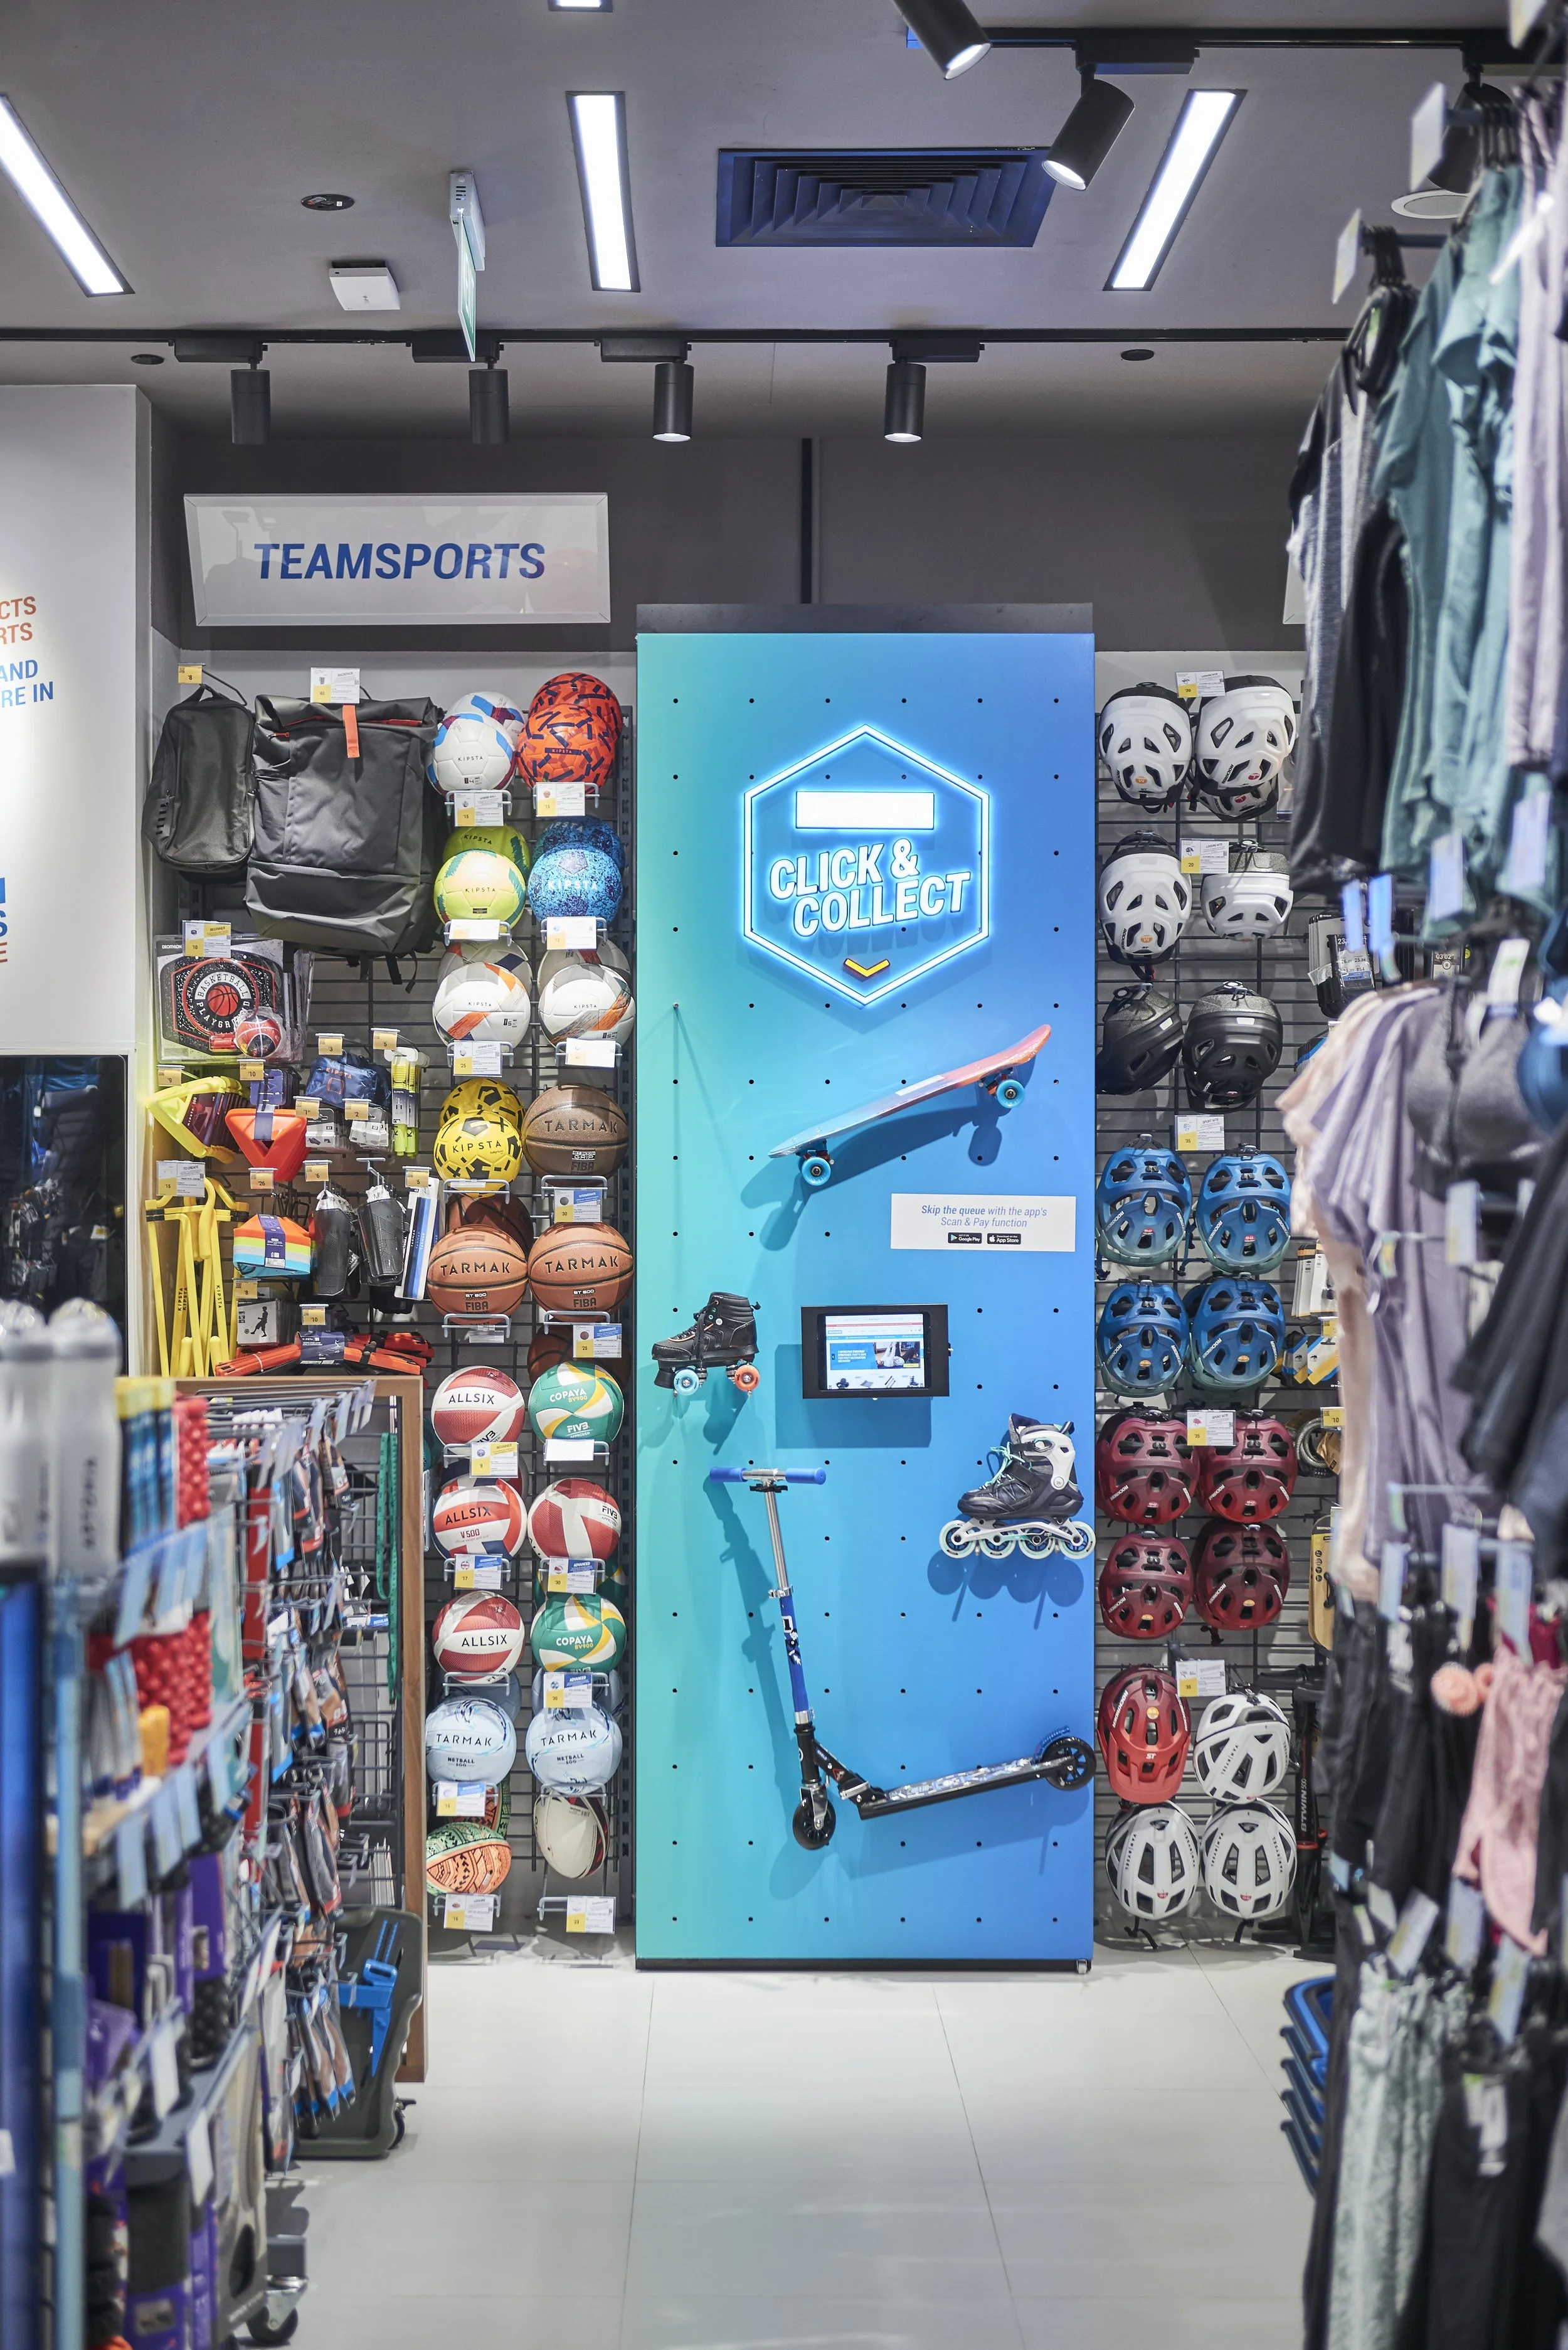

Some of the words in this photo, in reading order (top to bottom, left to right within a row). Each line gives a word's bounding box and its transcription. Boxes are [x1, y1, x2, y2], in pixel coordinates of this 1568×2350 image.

[254, 543, 545, 580] TEAMSPORTS
[33, 681, 54, 702] IN
[464, 834, 492, 846] KIPSTA
[770, 843, 884, 900] CLICK
[891, 838, 919, 879] &
[548, 880, 598, 891] KIPSTA
[793, 871, 971, 937] COLLECT
[197, 973, 249, 998] BASKETBALL
[326, 1068, 352, 1079] KIPSTA
[544, 1119, 618, 1134] TARMAK
[452, 1140, 502, 1154] KIPSTA
[571, 1161, 595, 1171] FIBA
[921, 1205, 941, 1216] Skip
[943, 1206, 956, 1215] the
[959, 1207, 985, 1217] queue
[988, 1206, 1006, 1215] with
[1009, 1206, 1022, 1216] the
[1024, 1208, 1047, 1218] app's
[941, 1216, 961, 1226] Scan
[965, 1217, 971, 1226] &
[973, 1218, 989, 1228] Pay
[992, 1217, 1027, 1227] function
[440, 1262, 511, 1277] TARMAK
[544, 1255, 620, 1273] TARMAK
[465, 1301, 489, 1311] FIBA
[573, 1297, 596, 1308] FIBA
[448, 1393, 494, 1405] ALLSIX
[549, 1388, 587, 1403] COPAYA
[568, 1395, 588, 1403] BV900
[445, 1506, 492, 1525] ALLSIX
[462, 1634, 507, 1647] ALLSIX
[556, 1635, 593, 1646] COPAYA
[1113, 1689, 1129, 1728] ROCKRIDER
[437, 1733, 492, 1747] TARMAK
[541, 1730, 597, 1747] TARMAK
[556, 1753, 585, 1762] NETBALL
[1146, 1752, 1156, 1760] ST
